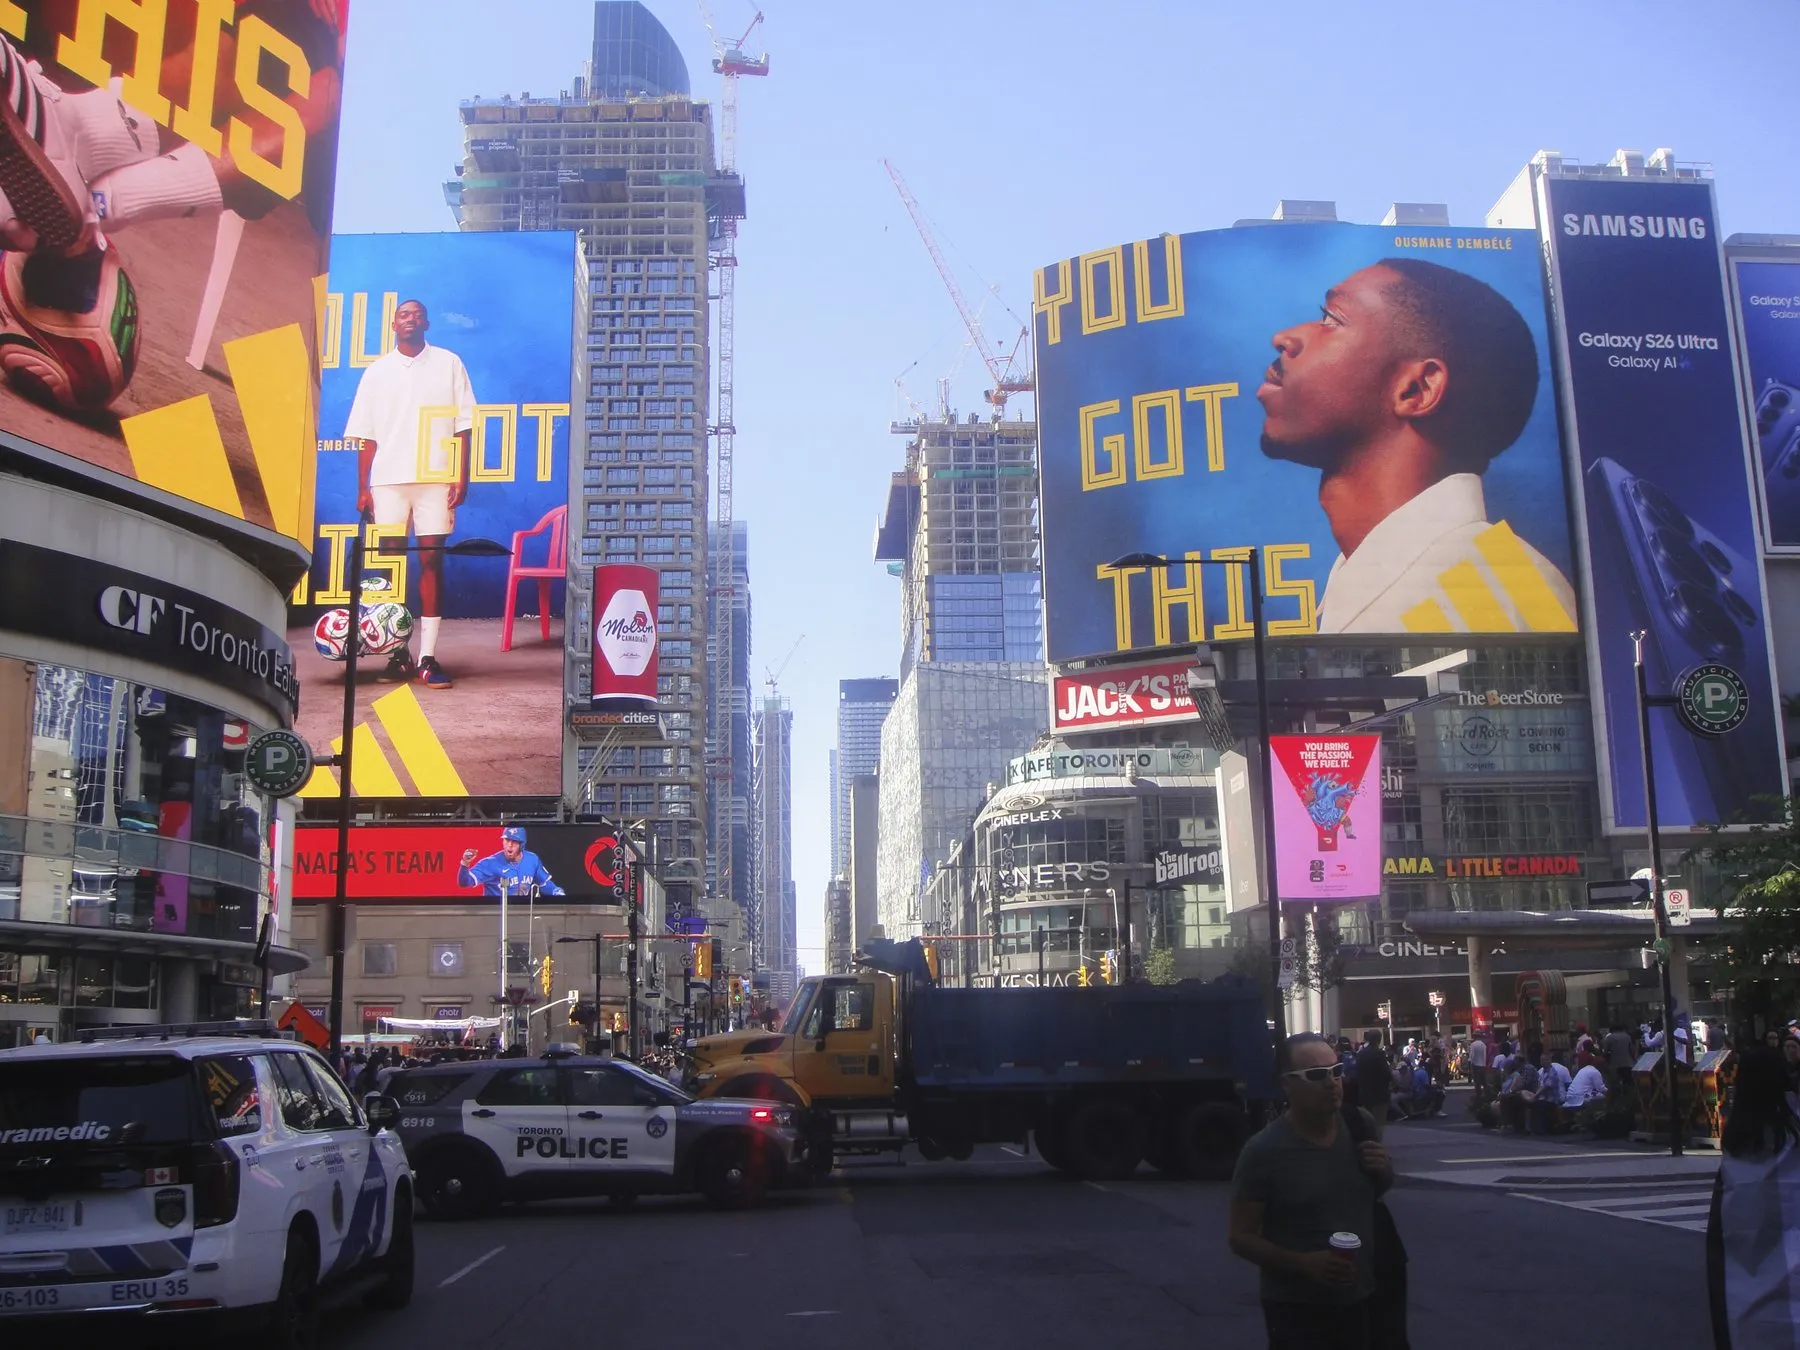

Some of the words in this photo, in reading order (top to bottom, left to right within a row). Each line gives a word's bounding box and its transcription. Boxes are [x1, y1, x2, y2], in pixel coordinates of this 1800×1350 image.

[1563, 213, 1706, 239] SAMSUNG
[1395, 236, 1453, 249] OUSMANE
[1457, 236, 1513, 250] DEMBÉLÉ
[1033, 234, 1185, 346] YOU
[1750, 295, 1792, 308] Galaxy
[1578, 331, 1642, 351] Galaxy
[1646, 334, 1675, 349] S26
[1678, 334, 1719, 350] Ultra
[1608, 355, 1660, 372] Galaxy
[416, 403, 570, 483] GOT
[1079, 382, 1239, 492] GOT
[1097, 543, 1318, 652] THIS
[100, 585, 166, 635] CF
[174, 603, 269, 679] Toronto
[603, 618, 654, 640] Molson
[1174, 685, 1190, 695] TH
[1685, 667, 1744, 697] MUNICIPAL
[1059, 675, 1171, 721] JACK'S
[1173, 674, 1190, 683] PA
[1459, 691, 1486, 706] The
[1487, 690, 1524, 706] Beer
[1524, 689, 1563, 705] Store
[1704, 682, 1728, 709] P
[572, 711, 656, 725] brandedcities
[1687, 704, 1746, 730] PARKING
[250, 732, 303, 757] MUNICIPAL
[1305, 743, 1323, 751] YOU
[1324, 743, 1349, 751] BRING
[1529, 743, 1561, 754] SOON
[265, 746, 289, 771] P
[1058, 753, 1152, 769] TORONTO
[1300, 751, 1316, 760] THE
[1318, 751, 1354, 760] PASSION.
[1305, 759, 1319, 768] WE
[1320, 759, 1339, 768] FUEL
[1340, 759, 1350, 768] IT.
[249, 765, 305, 789] PARKING
[1381, 766, 1403, 791] shi
[993, 809, 1062, 827] CINEPLEX
[383, 850, 444, 873] TEAM
[1159, 850, 1177, 864] The
[1383, 857, 1435, 875] AMA
[1503, 857, 1580, 876] CANADA
[402, 1118, 435, 1127] 6918
[518, 1127, 563, 1135] TORONTO
[516, 1137, 628, 1159] POLICE
[0, 1289, 59, 1308] 6-103
[111, 1284, 157, 1301] ERU
[164, 1279, 189, 1297] 35
